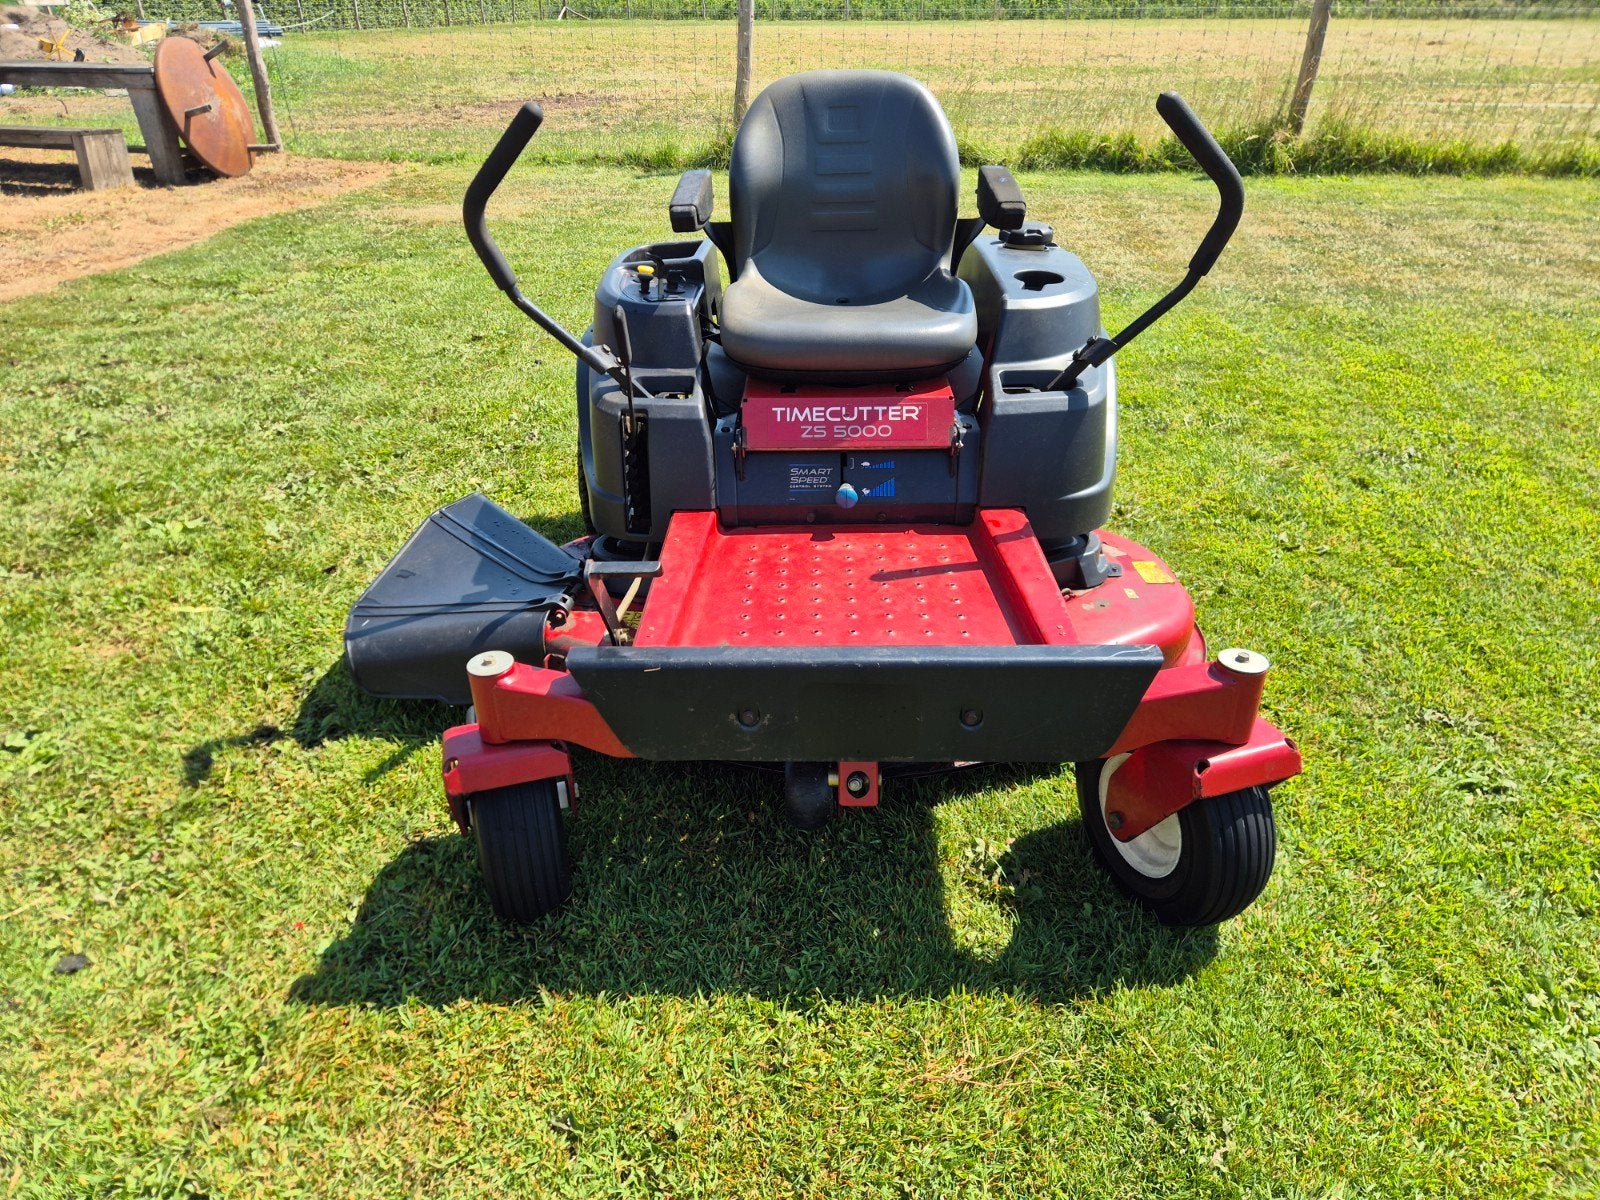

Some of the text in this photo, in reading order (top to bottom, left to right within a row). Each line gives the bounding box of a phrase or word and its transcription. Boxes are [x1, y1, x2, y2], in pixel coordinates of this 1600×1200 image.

[772, 406, 920, 422] TIMECUTTER
[801, 425, 893, 438] ZS 5000
[790, 468, 833, 476] SMART
[790, 476, 829, 484] SPEED
